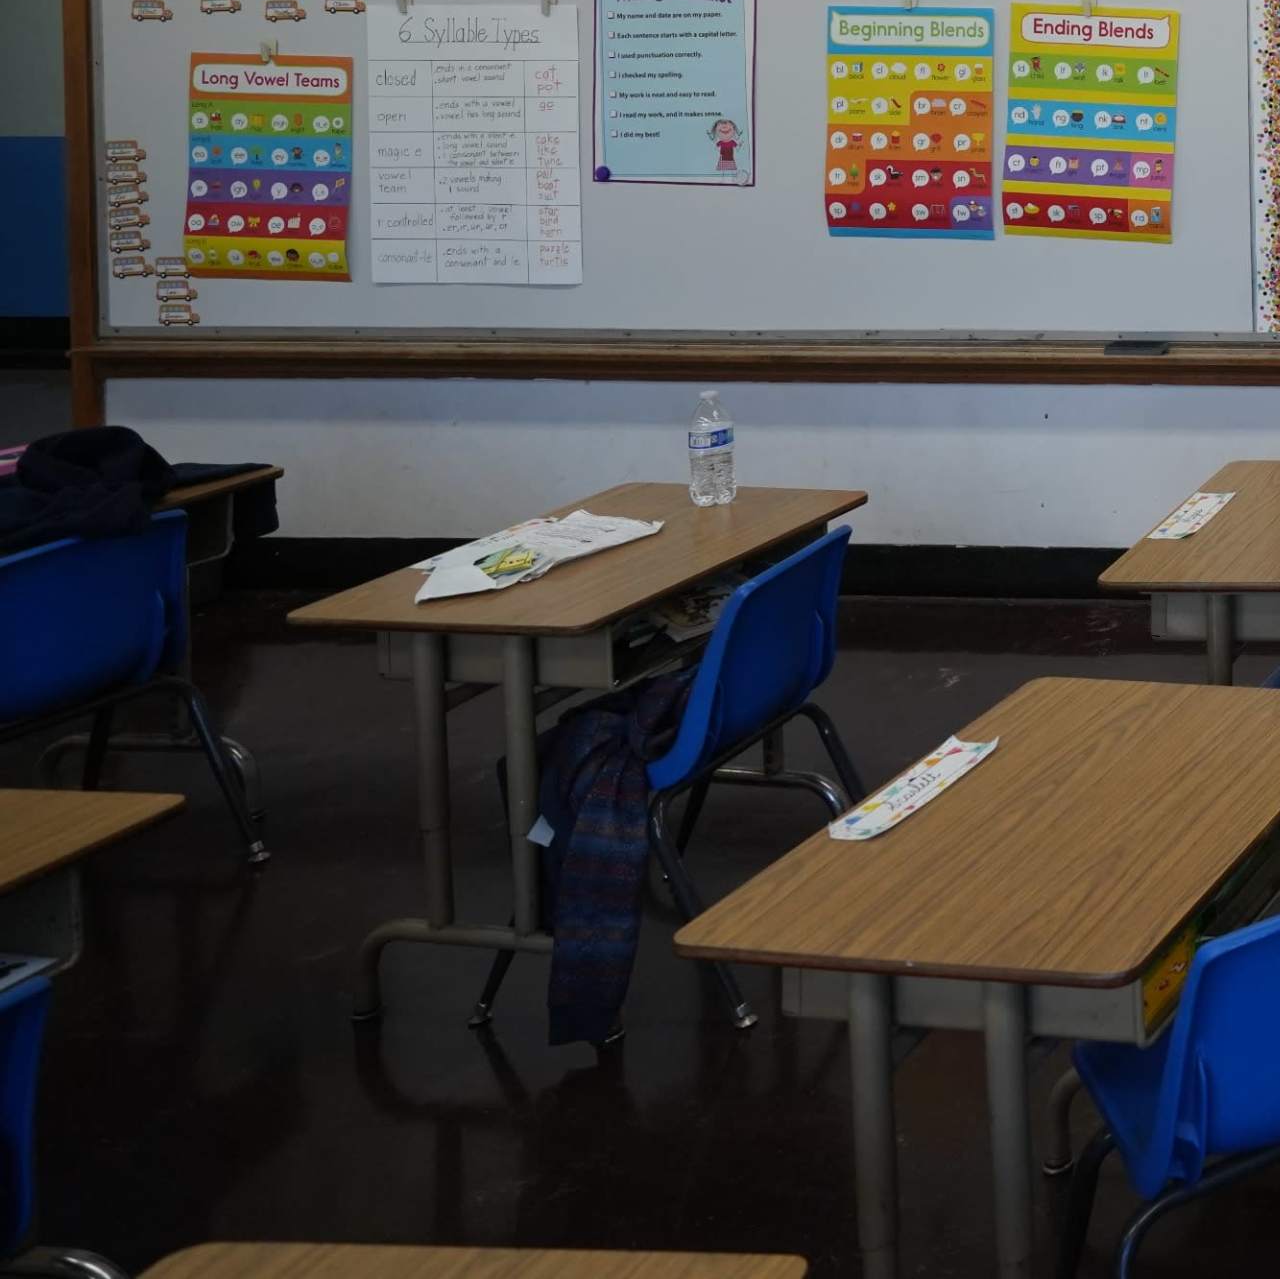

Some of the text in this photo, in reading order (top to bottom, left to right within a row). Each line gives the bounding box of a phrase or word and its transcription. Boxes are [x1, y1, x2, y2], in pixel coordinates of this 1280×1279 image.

[399, 16, 541, 51] 6 Syllable Types
[839, 20, 985, 41] Beginning Blends
[1033, 18, 1154, 41] Ending Blends
[201, 70, 340, 89] Long Vowel Teams
[375, 68, 417, 86] closed
[376, 112, 408, 126] open
[377, 147, 411, 159] magic
